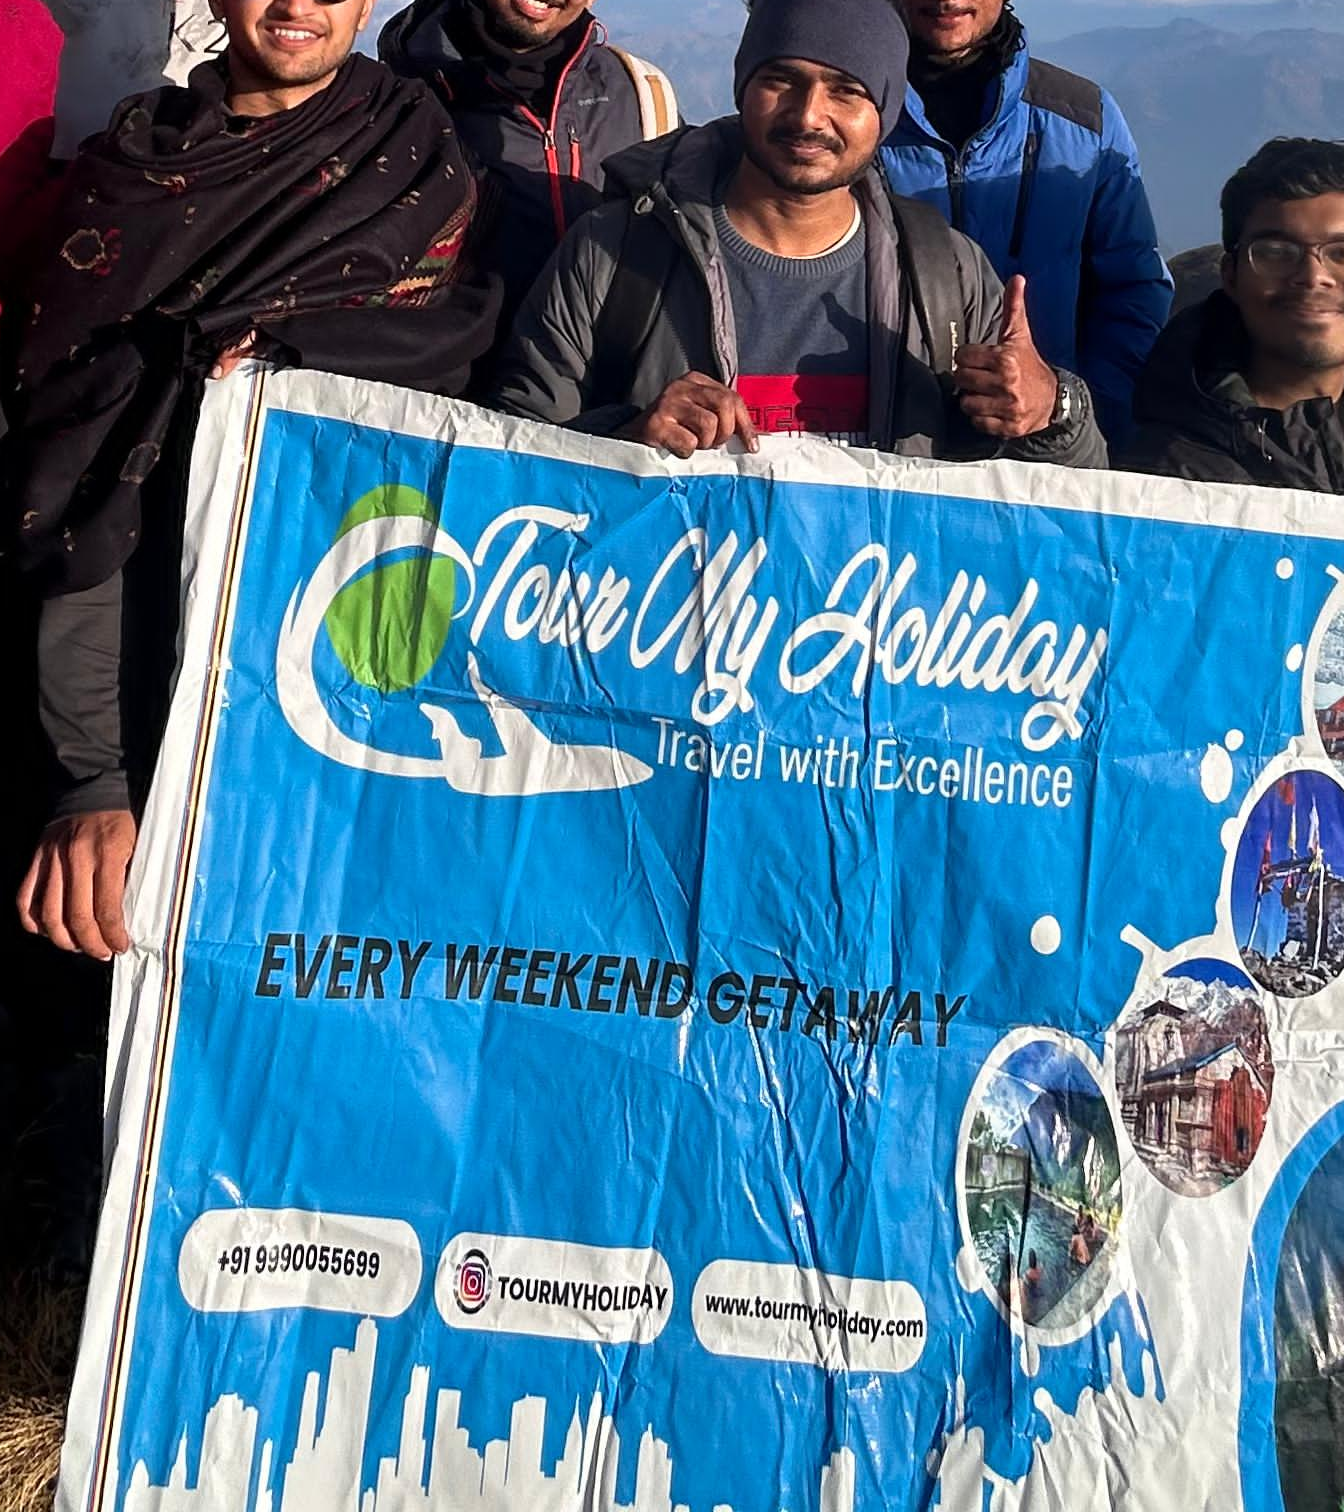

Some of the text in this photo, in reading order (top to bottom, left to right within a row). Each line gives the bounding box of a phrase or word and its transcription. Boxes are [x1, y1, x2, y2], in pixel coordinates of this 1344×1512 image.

[470, 505, 1108, 752] Tour My Holiday
[651, 716, 1073, 808] Travel with Excellence
[256, 932, 968, 1047] EVERY WEEKEND GETAWAY
[218, 1243, 380, 1279] +91 9990055699
[497, 1276, 668, 1312] TOURMYHOLIDAY
[705, 1294, 924, 1342] www.tourmyholiday.com
